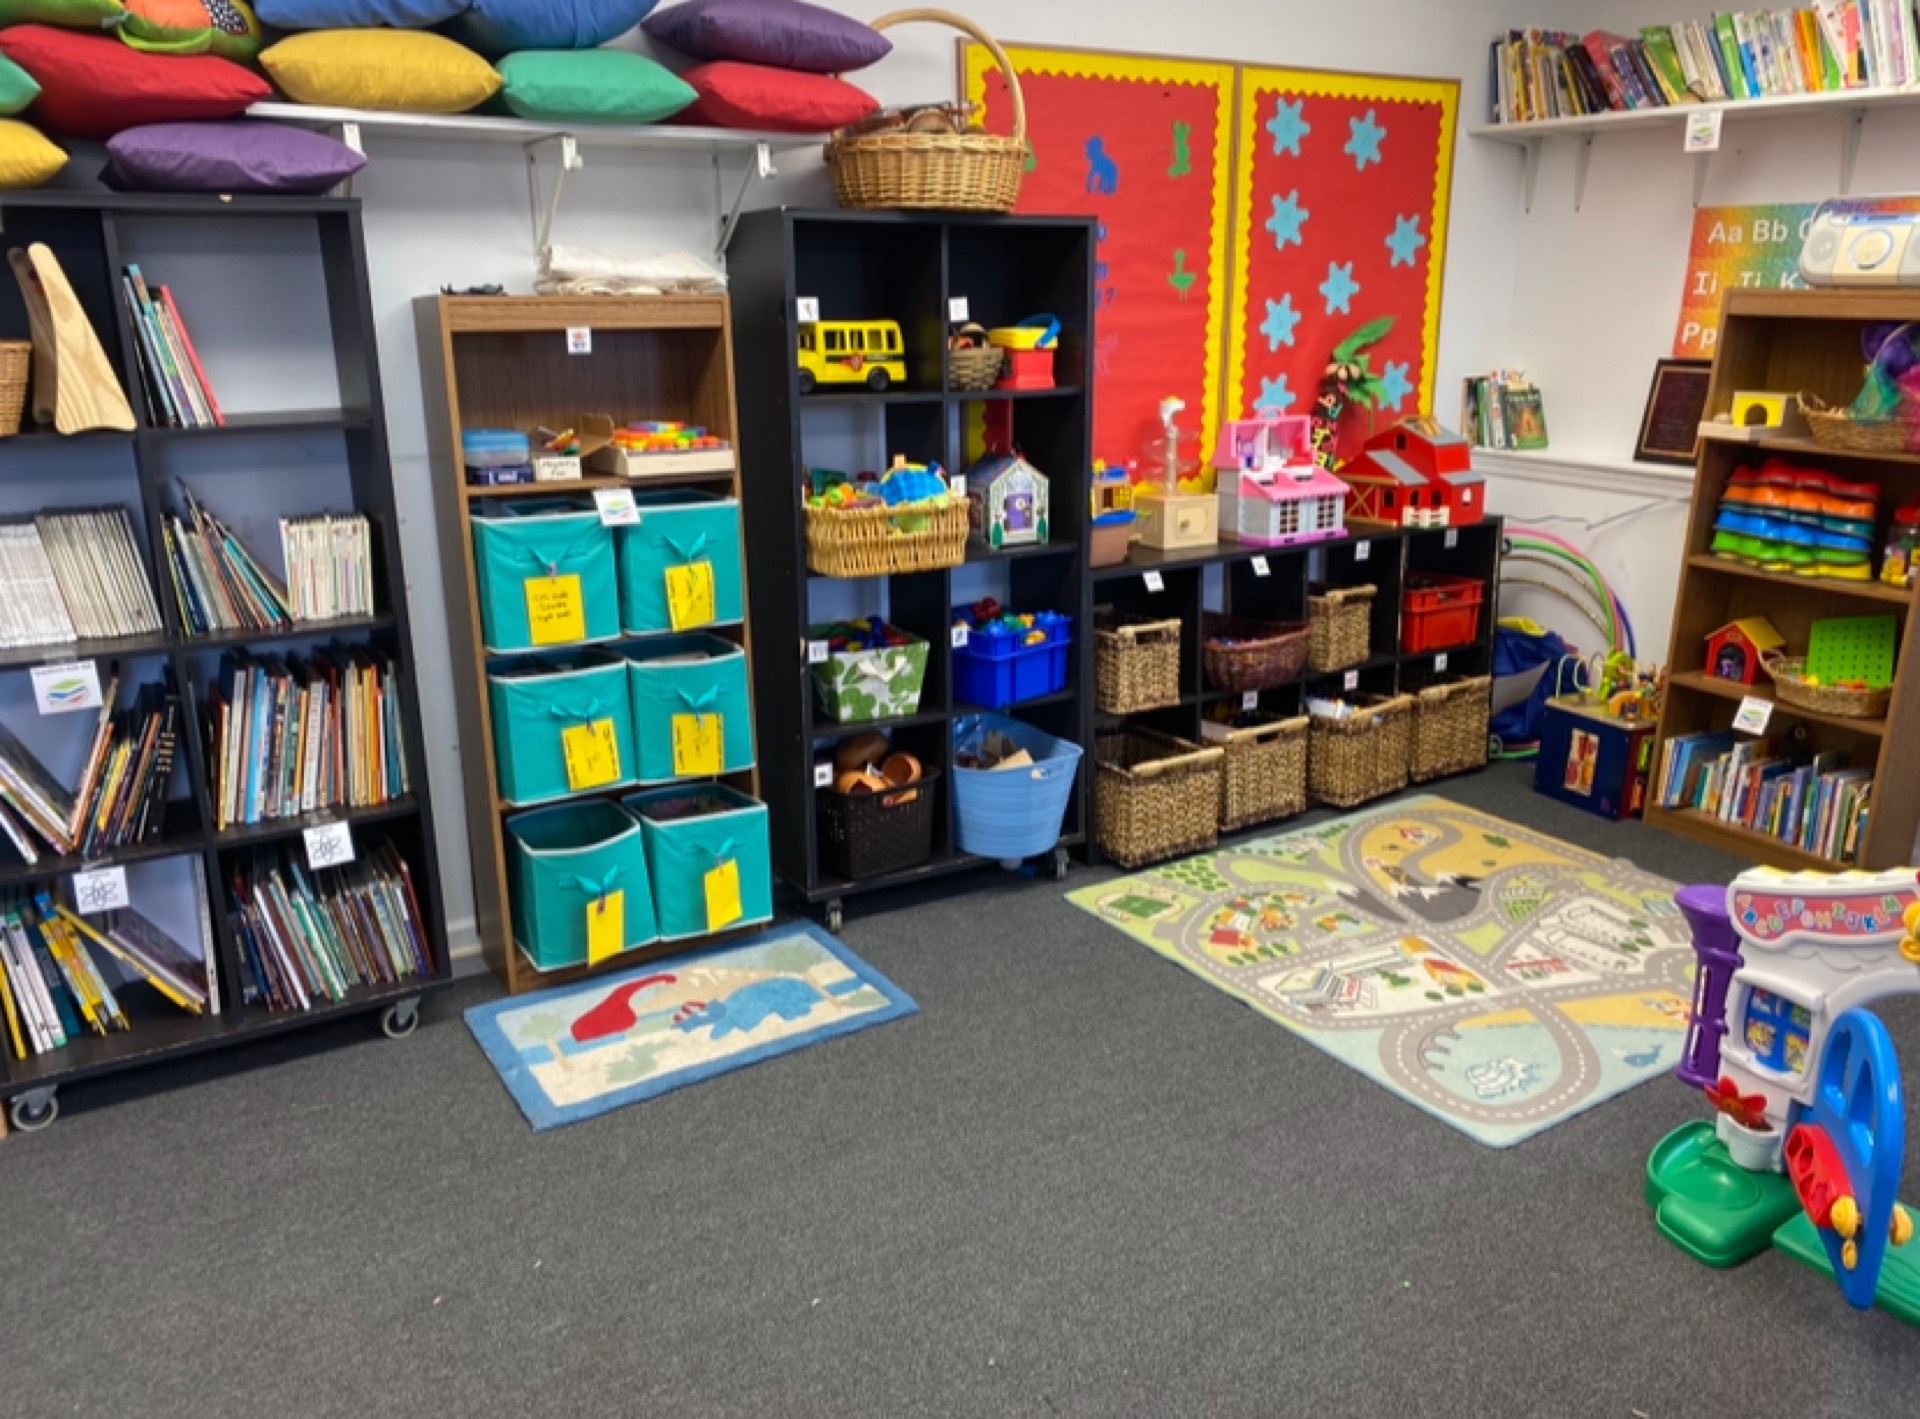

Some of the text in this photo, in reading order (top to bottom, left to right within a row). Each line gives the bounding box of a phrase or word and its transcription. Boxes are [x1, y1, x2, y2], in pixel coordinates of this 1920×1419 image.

[1708, 221, 1743, 244] Aa
[1752, 219, 1788, 242] Bb
[1692, 270, 1718, 295] Ii
[1780, 270, 1808, 289] K
[1680, 321, 1717, 349] Pp
